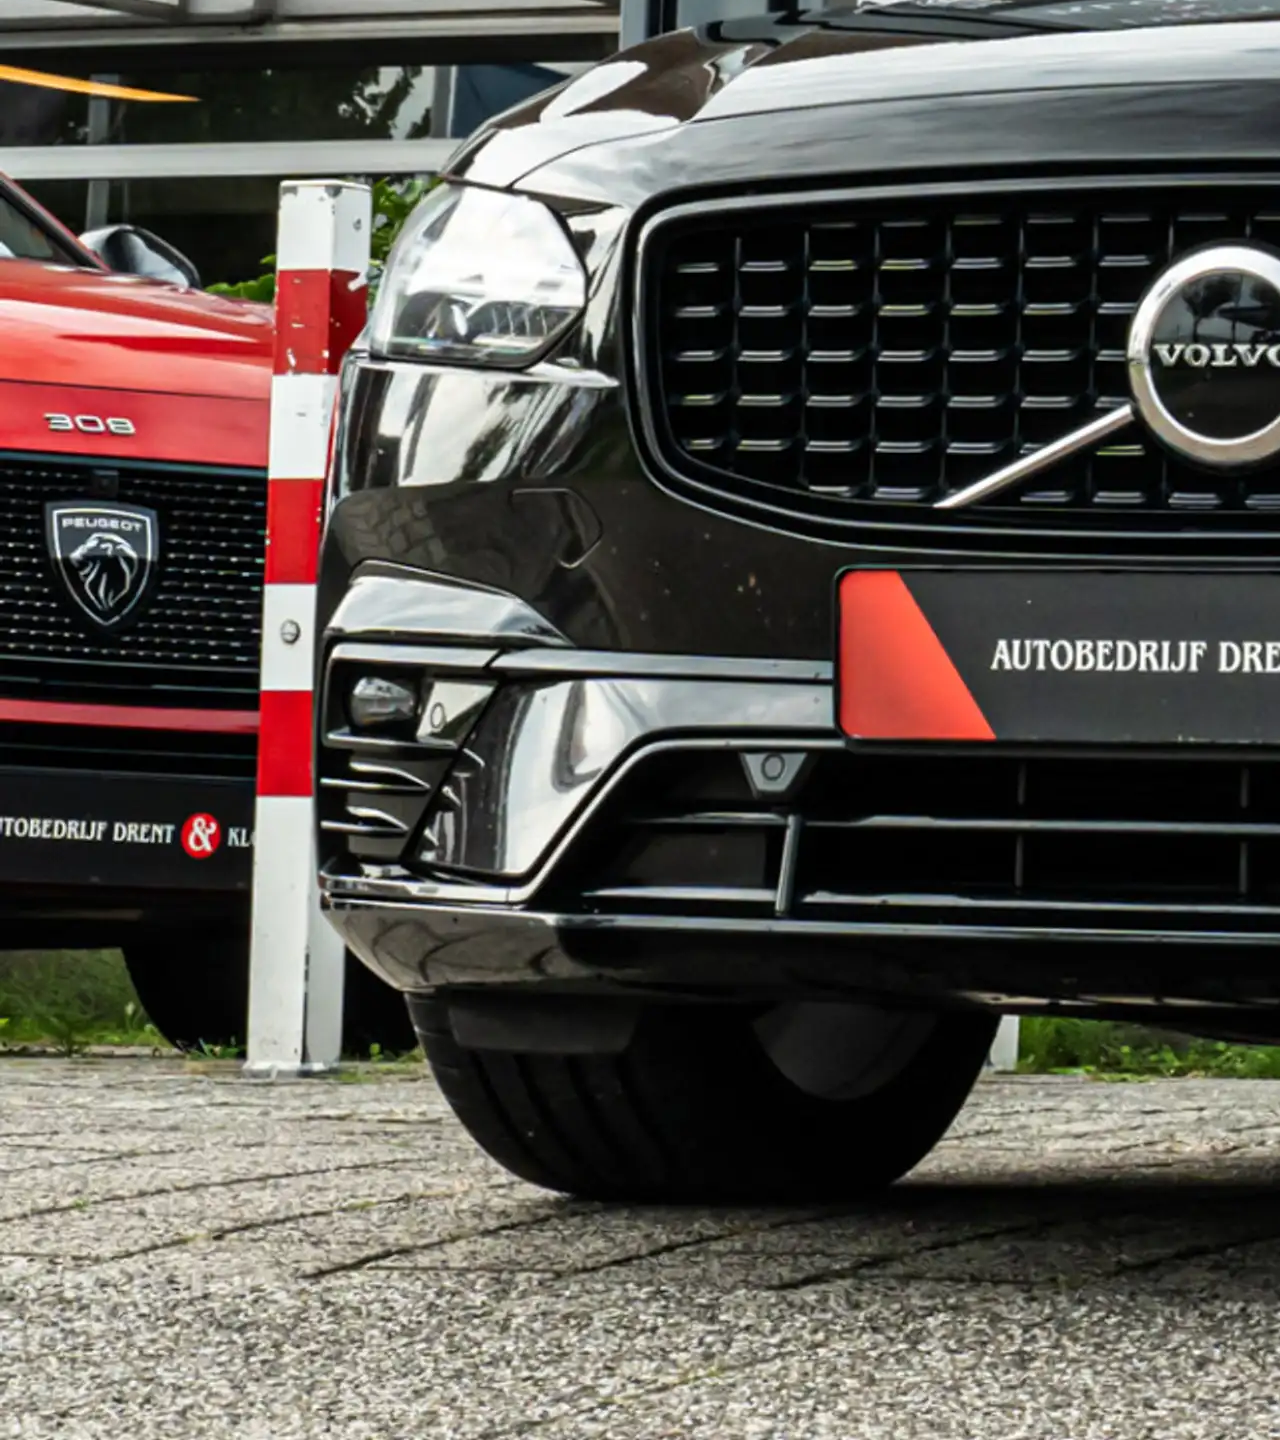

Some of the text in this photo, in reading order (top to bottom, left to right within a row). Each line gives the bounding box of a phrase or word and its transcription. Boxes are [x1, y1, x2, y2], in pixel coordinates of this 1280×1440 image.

[43, 412, 137, 436] 308
[61, 516, 143, 532] PEUGEOT
[990, 638, 1208, 673] AUTOBEDRIJF
[0, 816, 107, 842] TOBEDRIJF
[112, 821, 176, 844] DRENT
[187, 816, 218, 853] &
